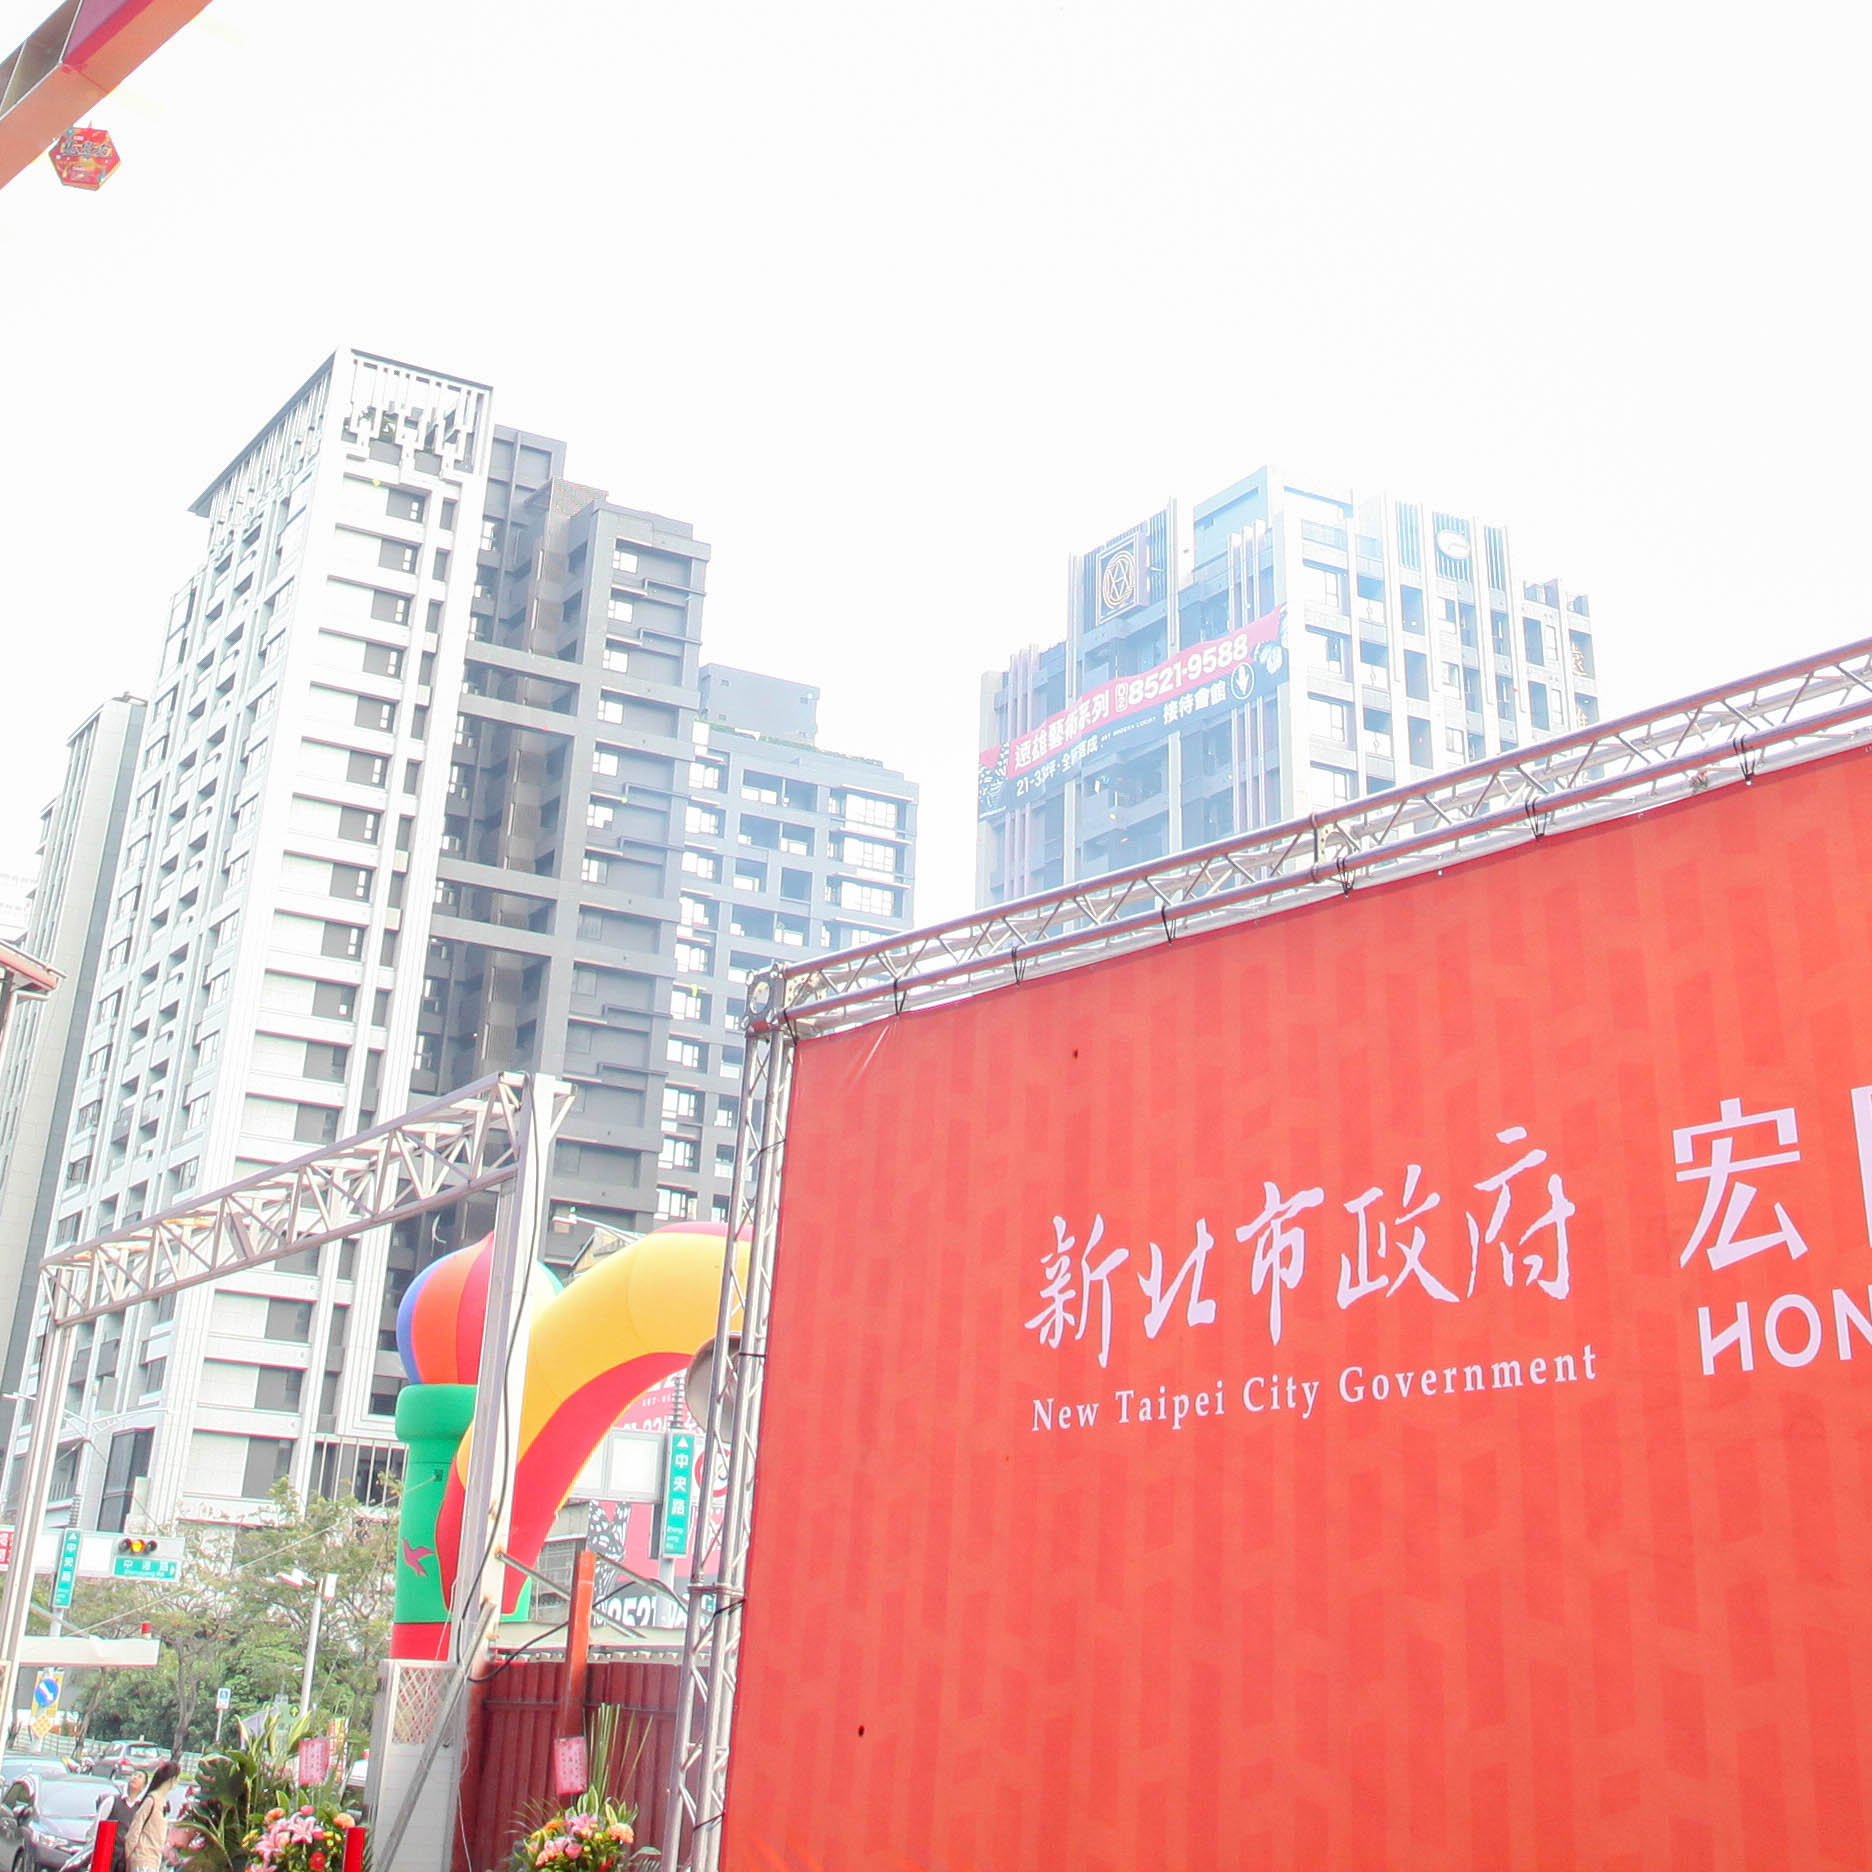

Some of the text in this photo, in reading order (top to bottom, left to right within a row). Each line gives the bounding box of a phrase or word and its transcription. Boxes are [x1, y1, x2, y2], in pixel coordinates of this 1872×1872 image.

[1127, 632, 1249, 706] 8521-9588
[1024, 1125, 1577, 1369] 新北市政府
[1031, 1344, 1597, 1432] New Taipei City Government
[671, 1453, 689, 1516] 中央路
